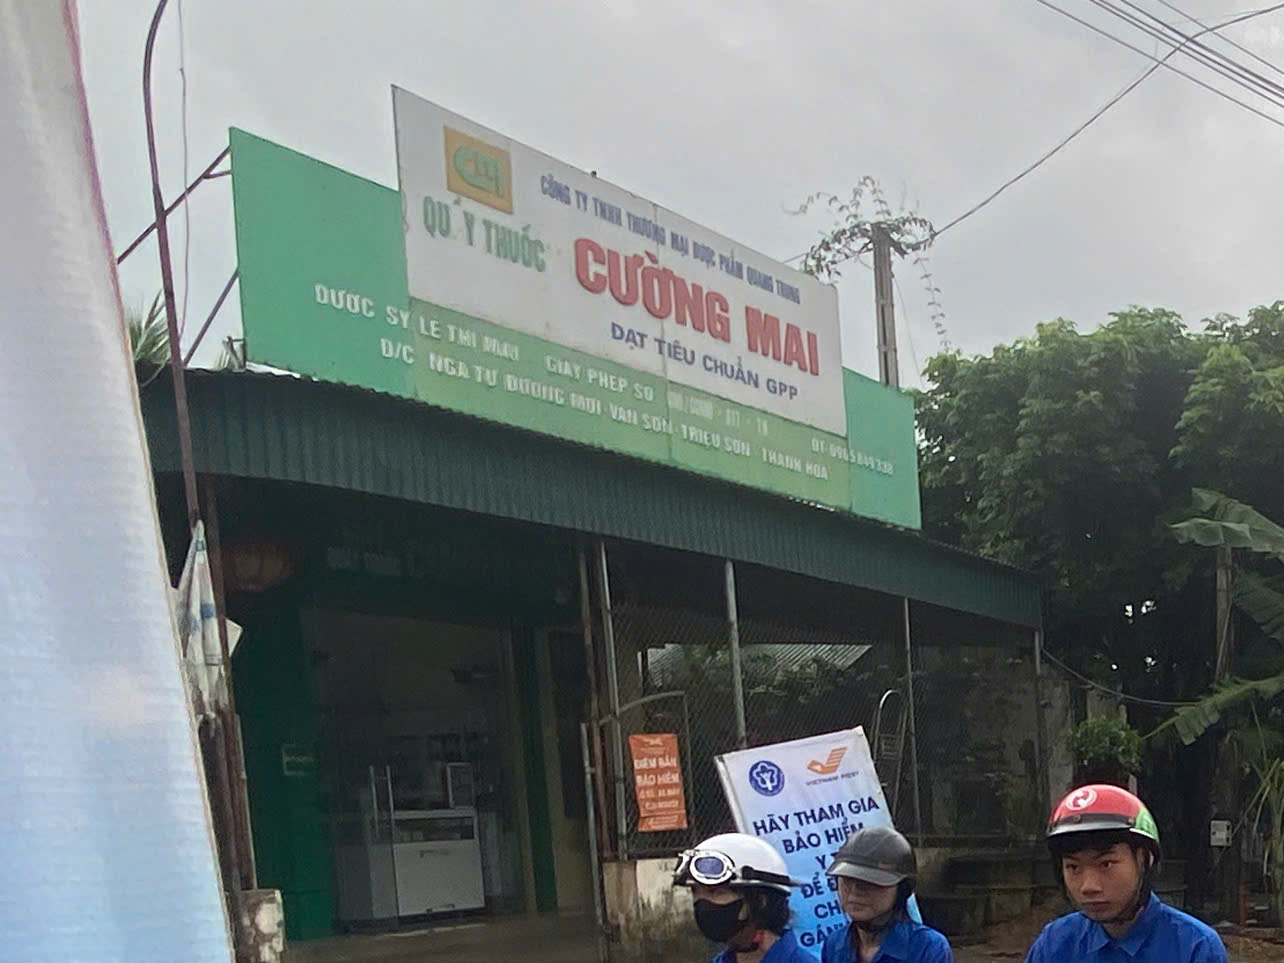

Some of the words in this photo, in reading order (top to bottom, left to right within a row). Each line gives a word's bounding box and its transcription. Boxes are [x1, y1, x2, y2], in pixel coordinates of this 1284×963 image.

[574, 190, 588, 213] TY
[574, 238, 731, 343] CƯỜNG
[745, 305, 820, 377] MAI
[654, 337, 696, 366] TIÊU
[766, 378, 799, 401] GPP
[752, 812, 790, 836] HÃY
[794, 803, 845, 827] THAM
[847, 796, 880, 815] GIA
[782, 829, 821, 854] BẢO
[800, 874, 825, 899] ĐỂ
